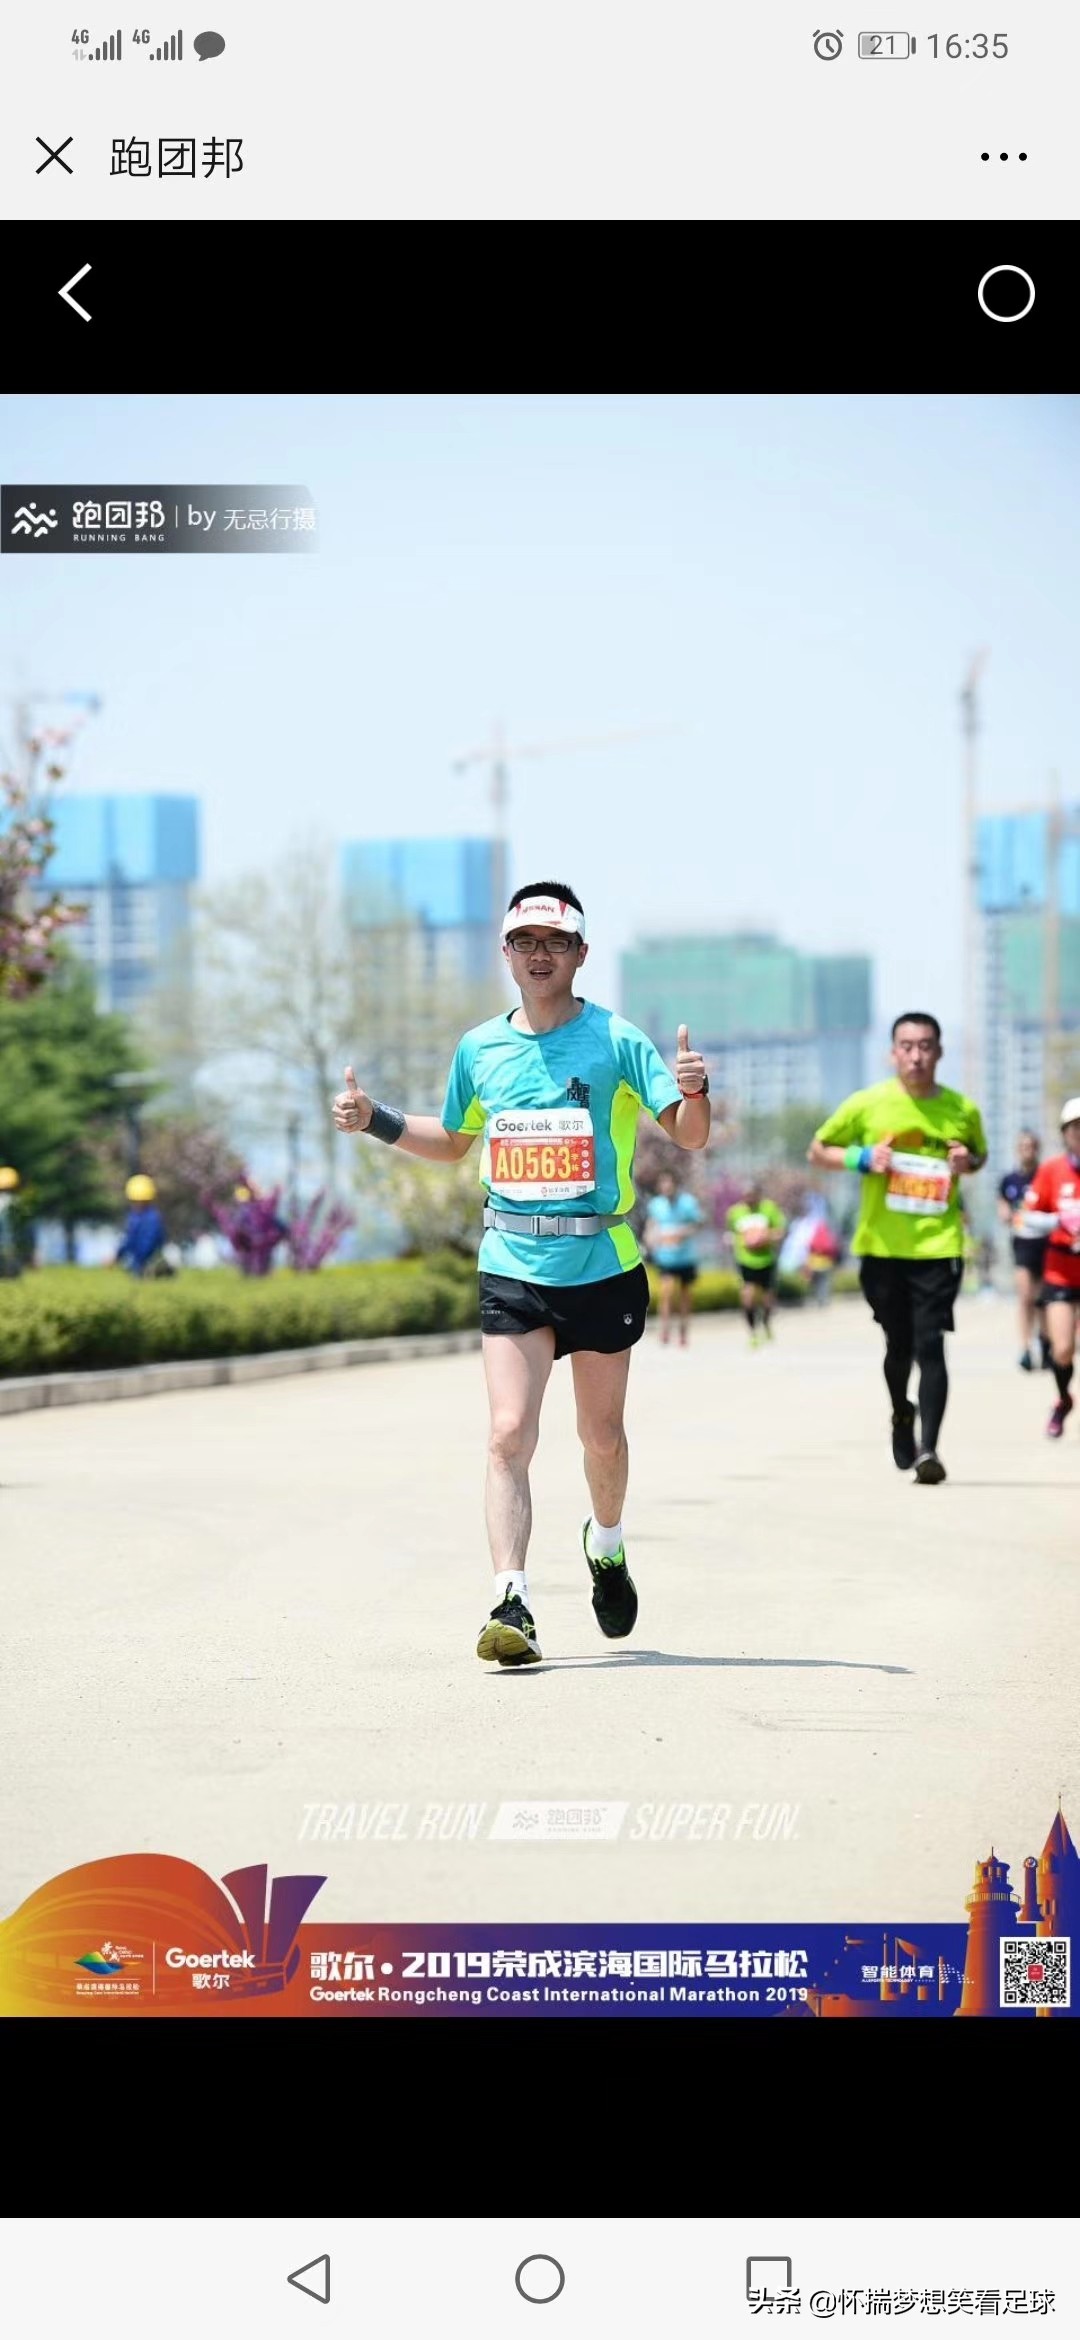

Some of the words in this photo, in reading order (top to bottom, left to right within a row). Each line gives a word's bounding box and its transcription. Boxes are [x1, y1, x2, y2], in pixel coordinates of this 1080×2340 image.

[71, 29, 90, 44] 4G
[132, 29, 150, 44] 4G
[870, 35, 895, 55] 21
[927, 33, 1009, 59] 16:35
[109, 136, 244, 179] 跑团邦
[495, 1118, 553, 1132] Goertek
[495, 1146, 572, 1180] A0563
